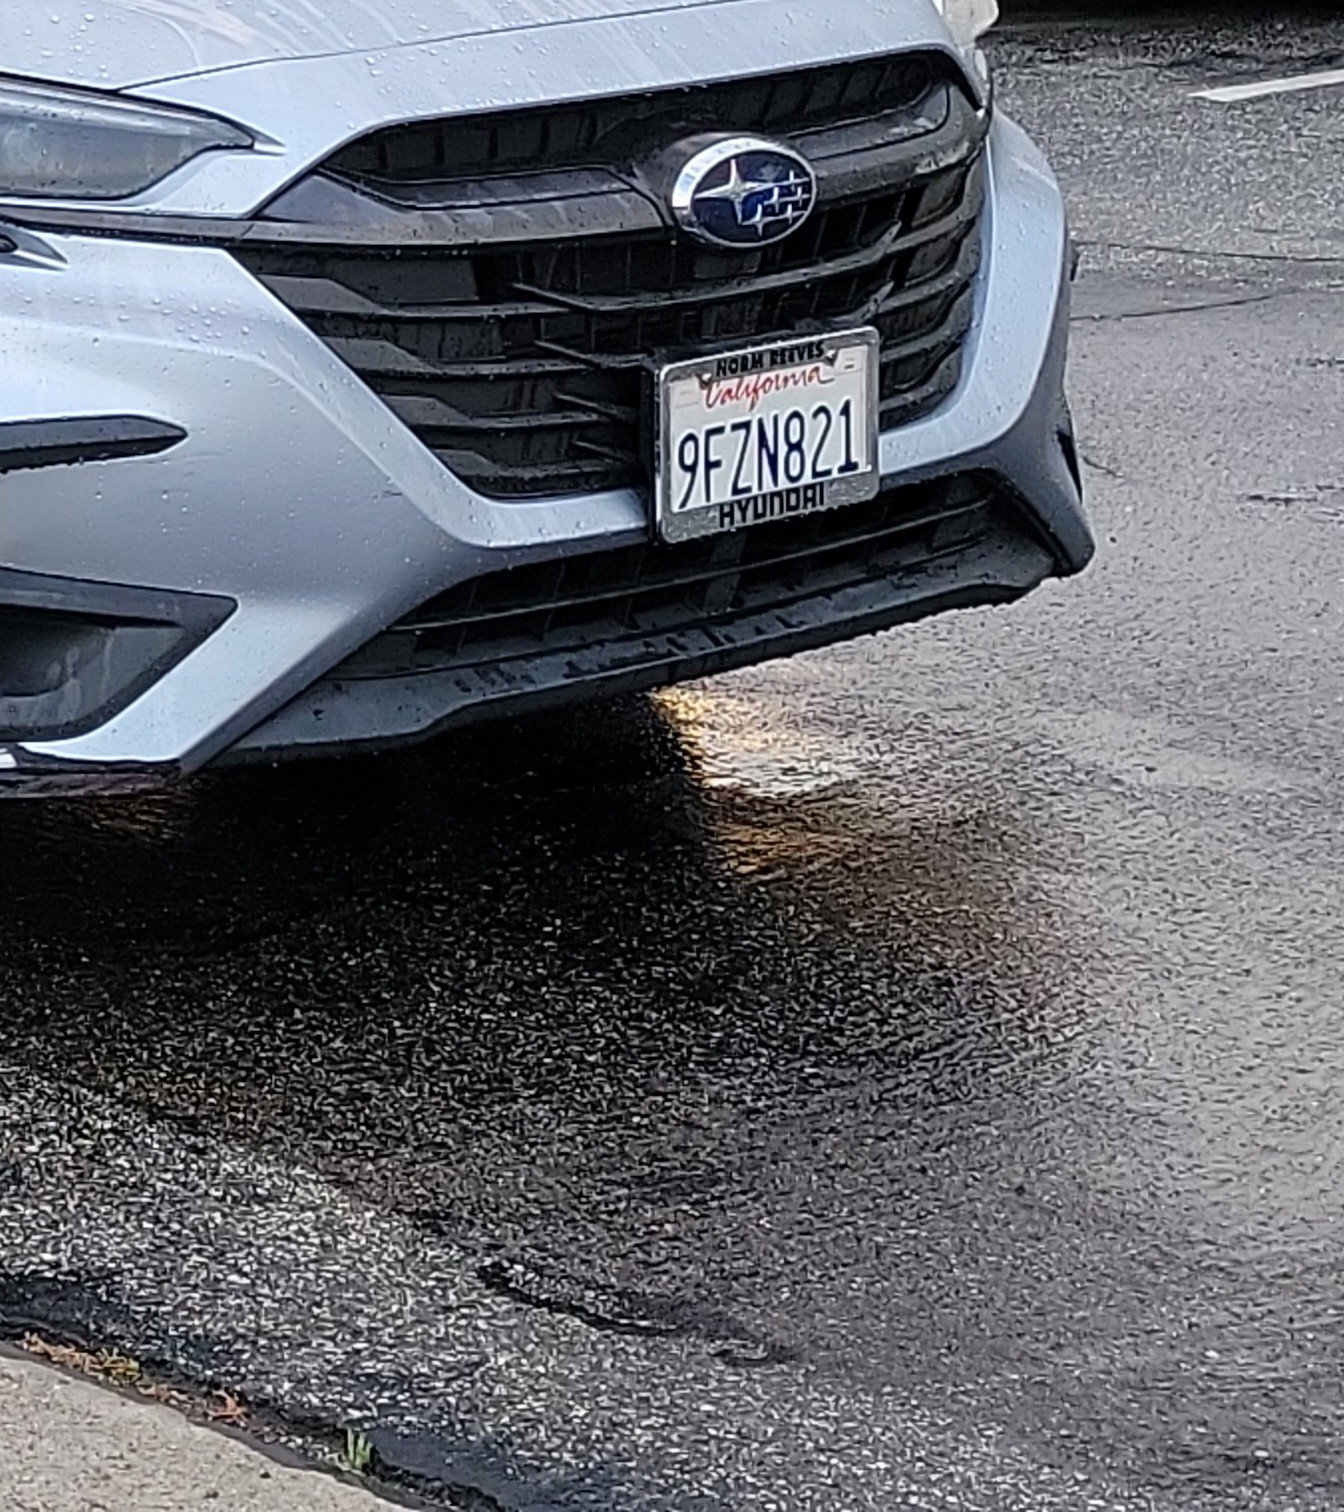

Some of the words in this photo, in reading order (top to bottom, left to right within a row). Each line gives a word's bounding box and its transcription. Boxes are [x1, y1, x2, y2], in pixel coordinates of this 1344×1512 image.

[716, 354, 764, 377] NORM
[770, 342, 825, 367] REEVES
[706, 366, 835, 412] California
[678, 399, 860, 510] 9FZN821
[719, 482, 825, 528] HYUNDAI
